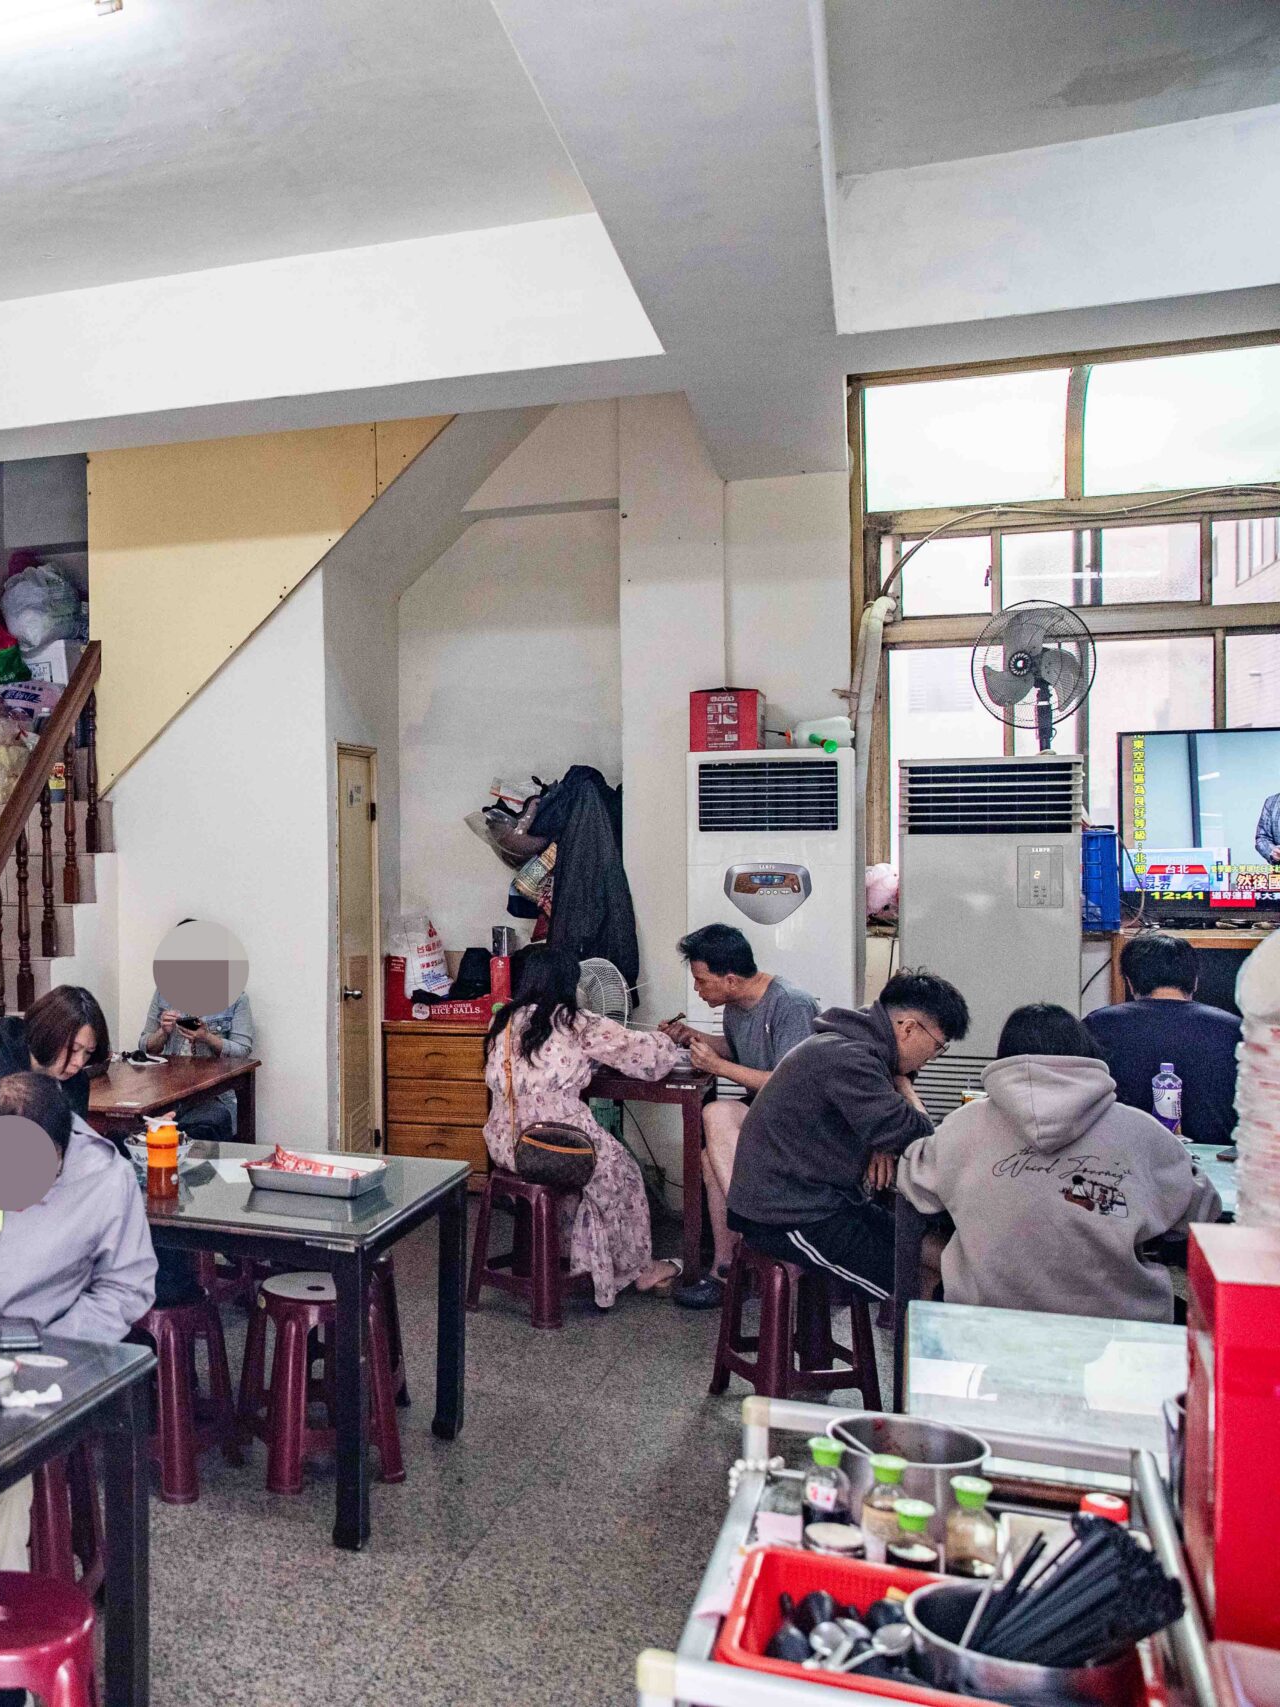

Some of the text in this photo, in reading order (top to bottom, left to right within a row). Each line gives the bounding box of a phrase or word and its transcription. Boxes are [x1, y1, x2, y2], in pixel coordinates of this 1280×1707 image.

[1165, 864, 1189, 874] 台北
[1033, 870, 1041, 879] 2
[1151, 891, 1205, 900] 12:41
[992, 1153, 1060, 1178] Weird
